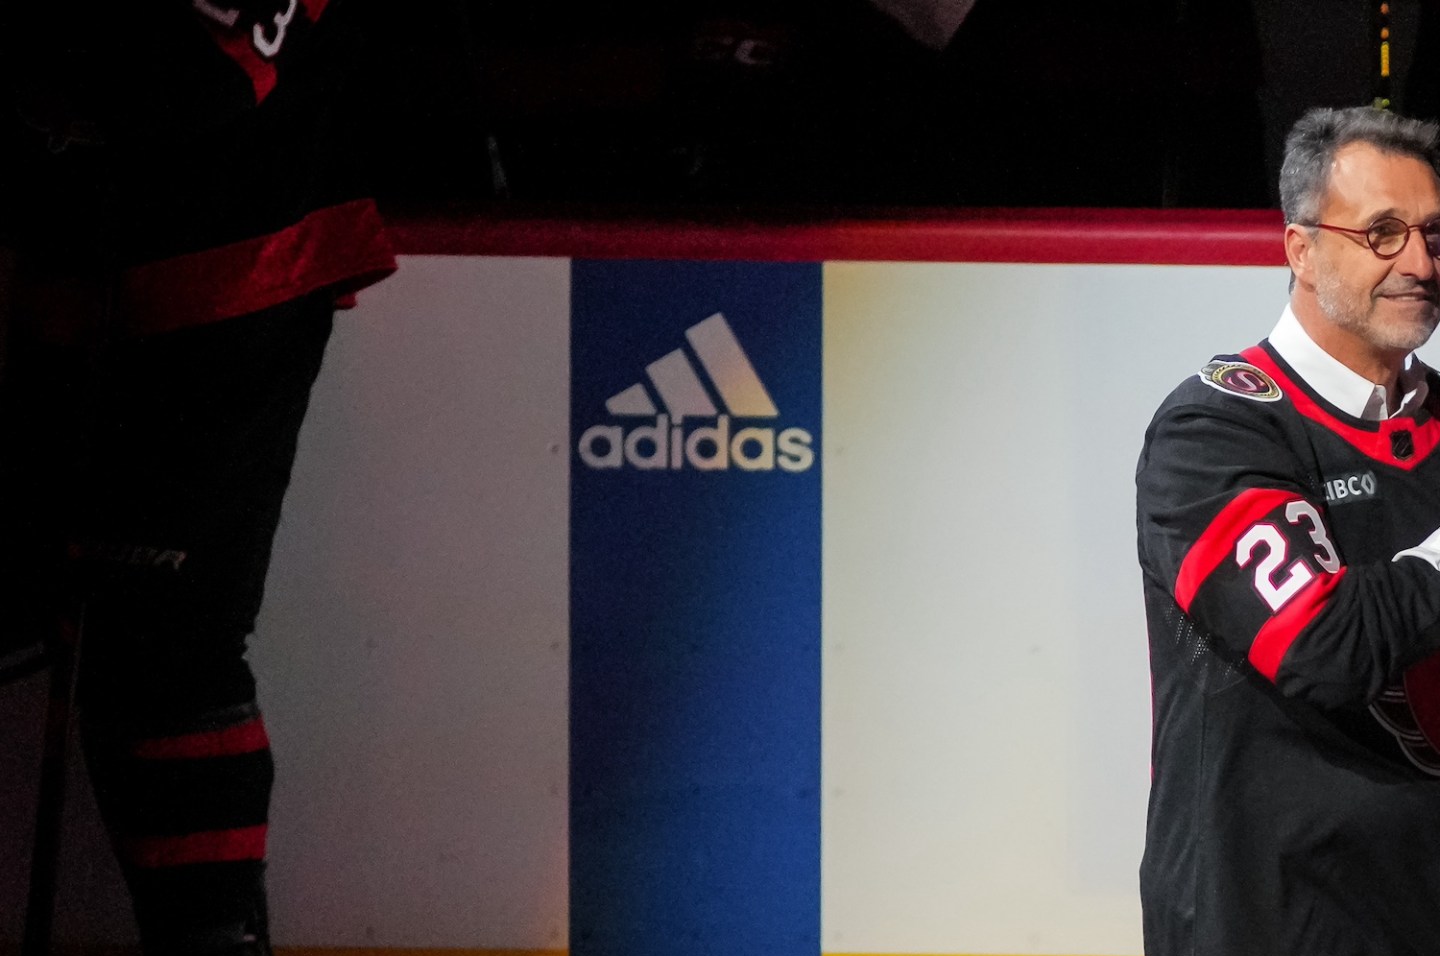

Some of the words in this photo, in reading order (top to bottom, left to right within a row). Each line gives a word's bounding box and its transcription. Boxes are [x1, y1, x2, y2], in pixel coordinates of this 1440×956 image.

[578, 413, 815, 473] adidas
[1324, 476, 1363, 500] IBC
[1235, 499, 1341, 612] 23
